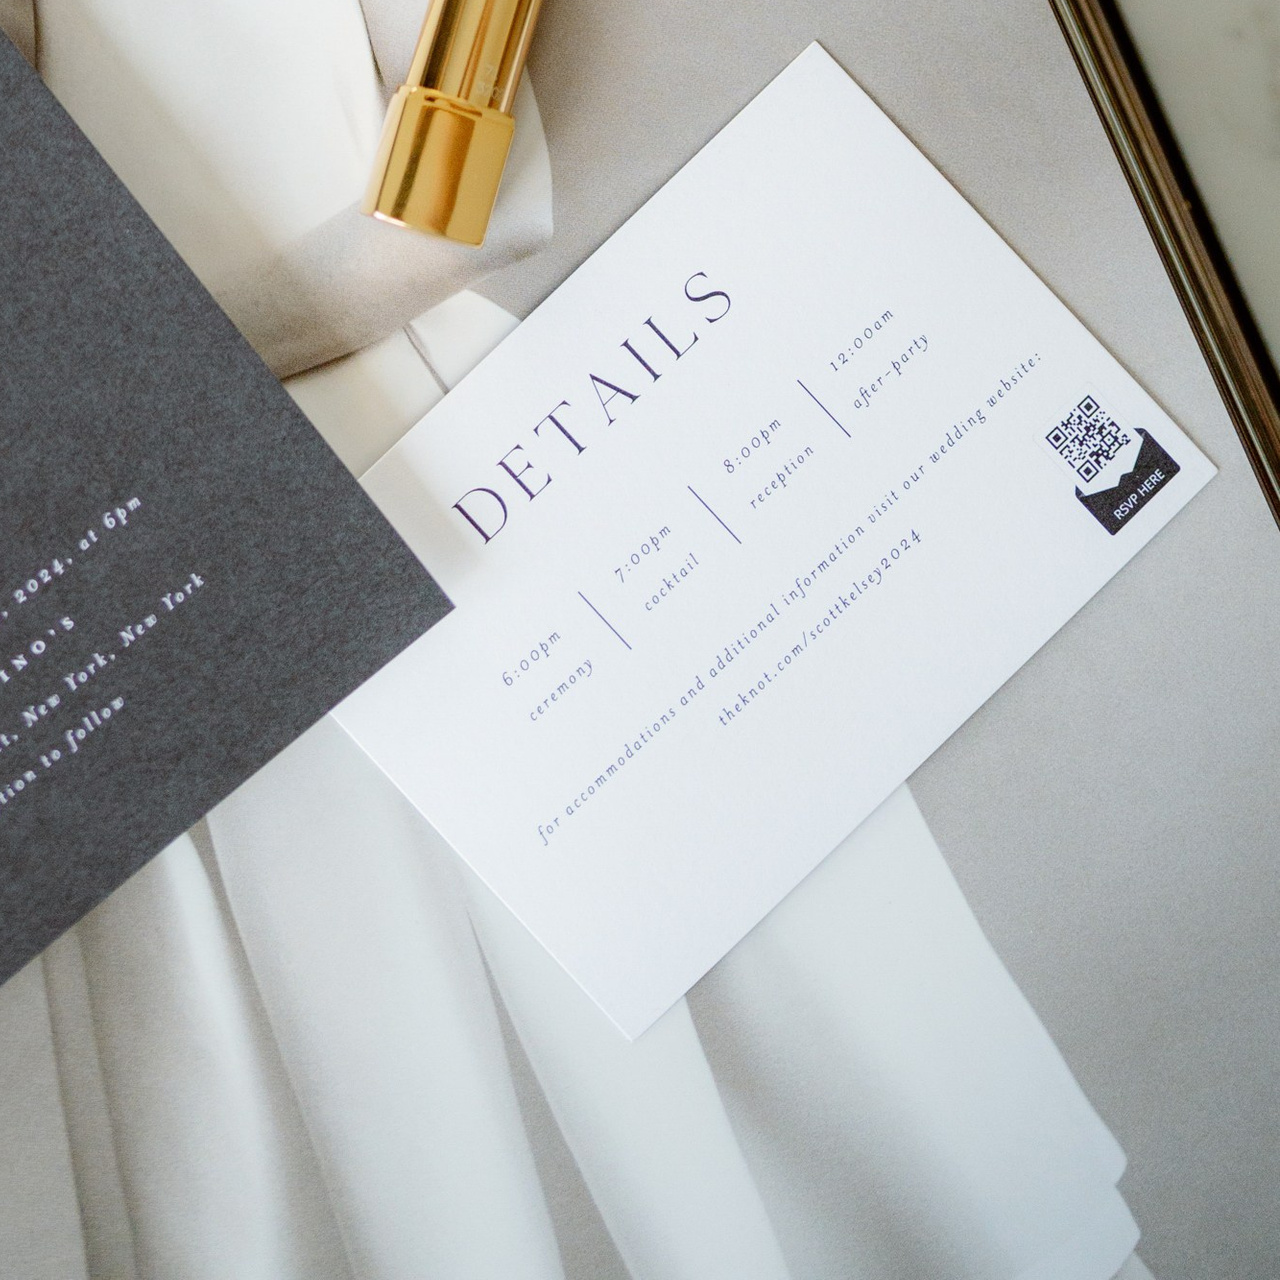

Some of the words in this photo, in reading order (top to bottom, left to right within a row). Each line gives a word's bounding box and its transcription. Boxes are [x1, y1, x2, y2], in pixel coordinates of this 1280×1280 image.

[829, 310, 894, 372] 12:00am
[853, 334, 928, 409] after-party
[451, 271, 732, 545] DETAILS
[723, 419, 782, 474] 8:00pm
[750, 446, 814, 509] reception
[1113, 494, 1139, 521] RSVP
[1137, 469, 1166, 498] HERE
[13, 558, 73, 604] 2024,
[79, 529, 98, 551] at
[103, 497, 142, 529] 6pm
[614, 525, 671, 584] 7:00pm
[644, 552, 699, 612] cocktail
[537, 817, 560, 847] for
[565, 707, 676, 816] accommodations
[679, 675, 706, 707] and
[709, 603, 781, 678] additional
[783, 526, 865, 606] information
[867, 490, 899, 524] visit
[902, 464, 925, 490] our
[929, 409, 987, 464] wedding
[986, 353, 1041, 408] website:
[718, 529, 922, 726] theknot.com/scottkelsey2024
[22, 693, 60, 728] New
[119, 614, 158, 648] New
[161, 573, 205, 611] York
[502, 632, 561, 687] 6:00pm
[529, 659, 593, 722] ceremony
[40, 749, 61, 768] to
[66, 696, 124, 754] follow
